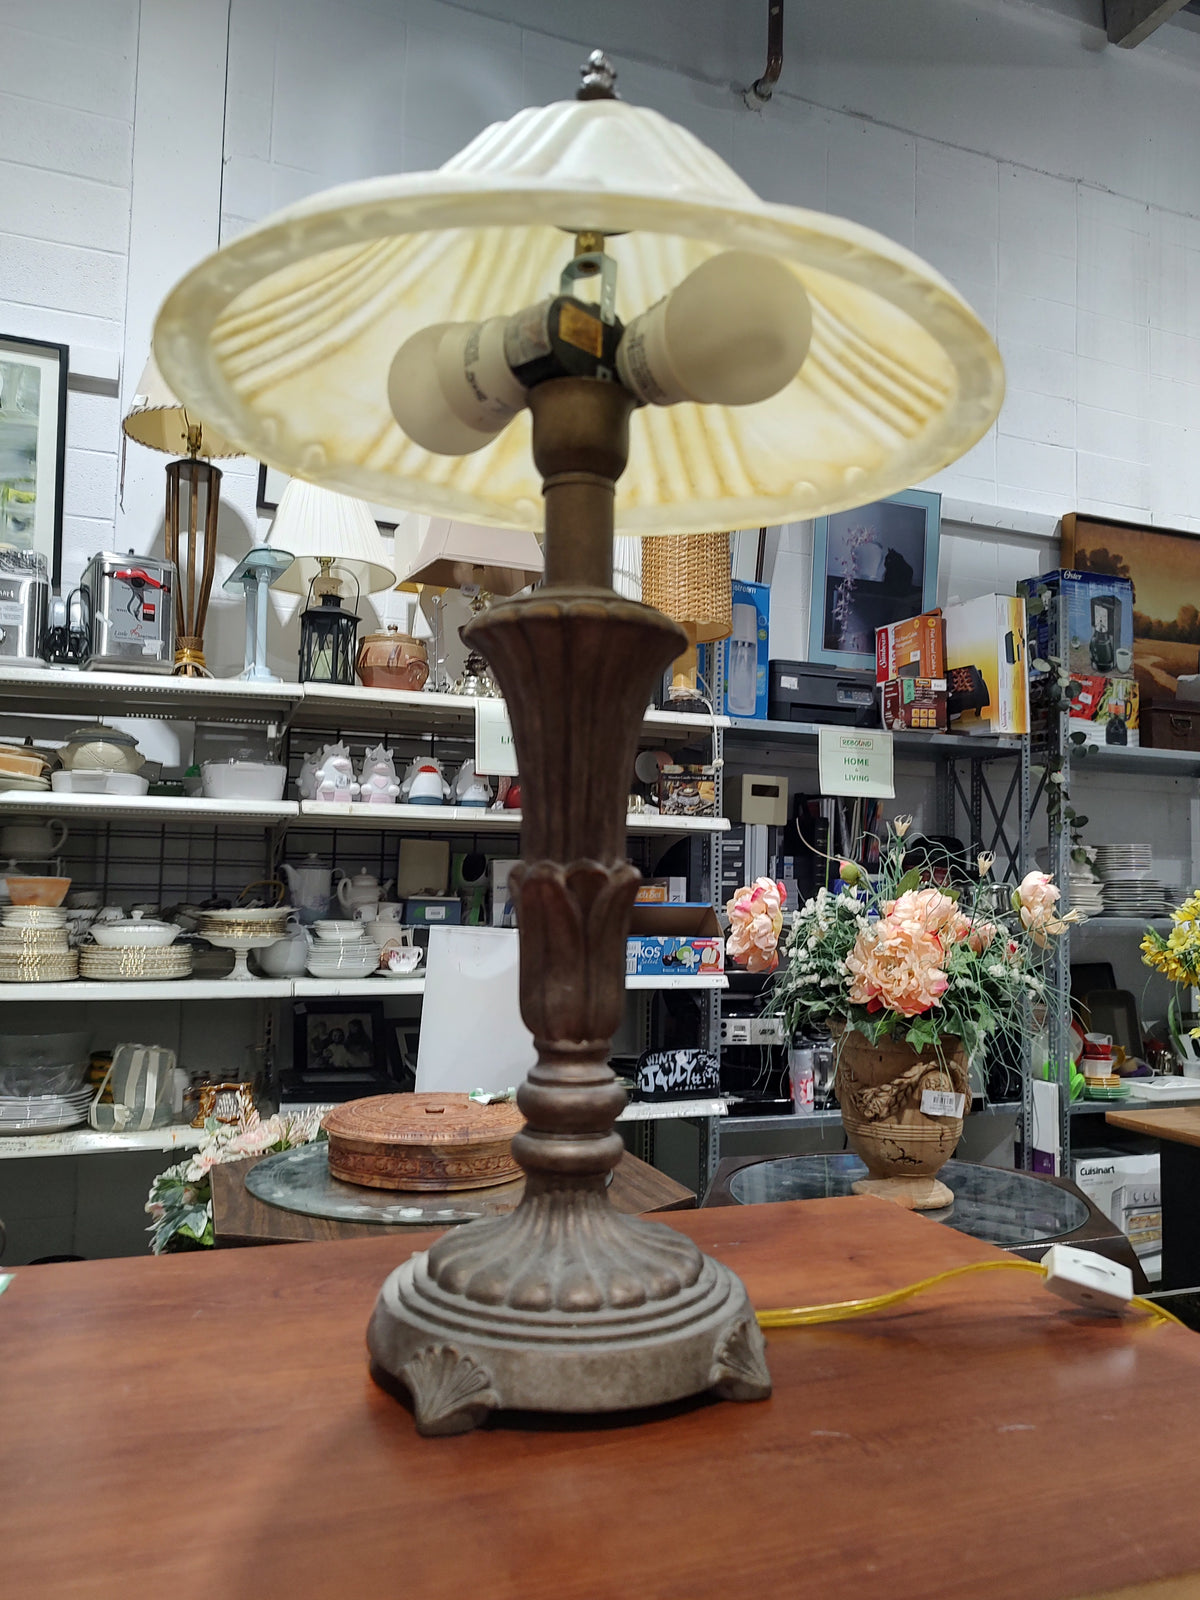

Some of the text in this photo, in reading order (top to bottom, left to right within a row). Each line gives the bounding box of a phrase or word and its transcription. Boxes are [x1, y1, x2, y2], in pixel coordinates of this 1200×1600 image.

[1063, 570, 1083, 580] Oster
[879, 632, 888, 670] Sunbeam
[843, 757, 870, 767] HOME
[844, 774, 870, 782] LIVING
[1080, 1165, 1115, 1176] Cuisinart
